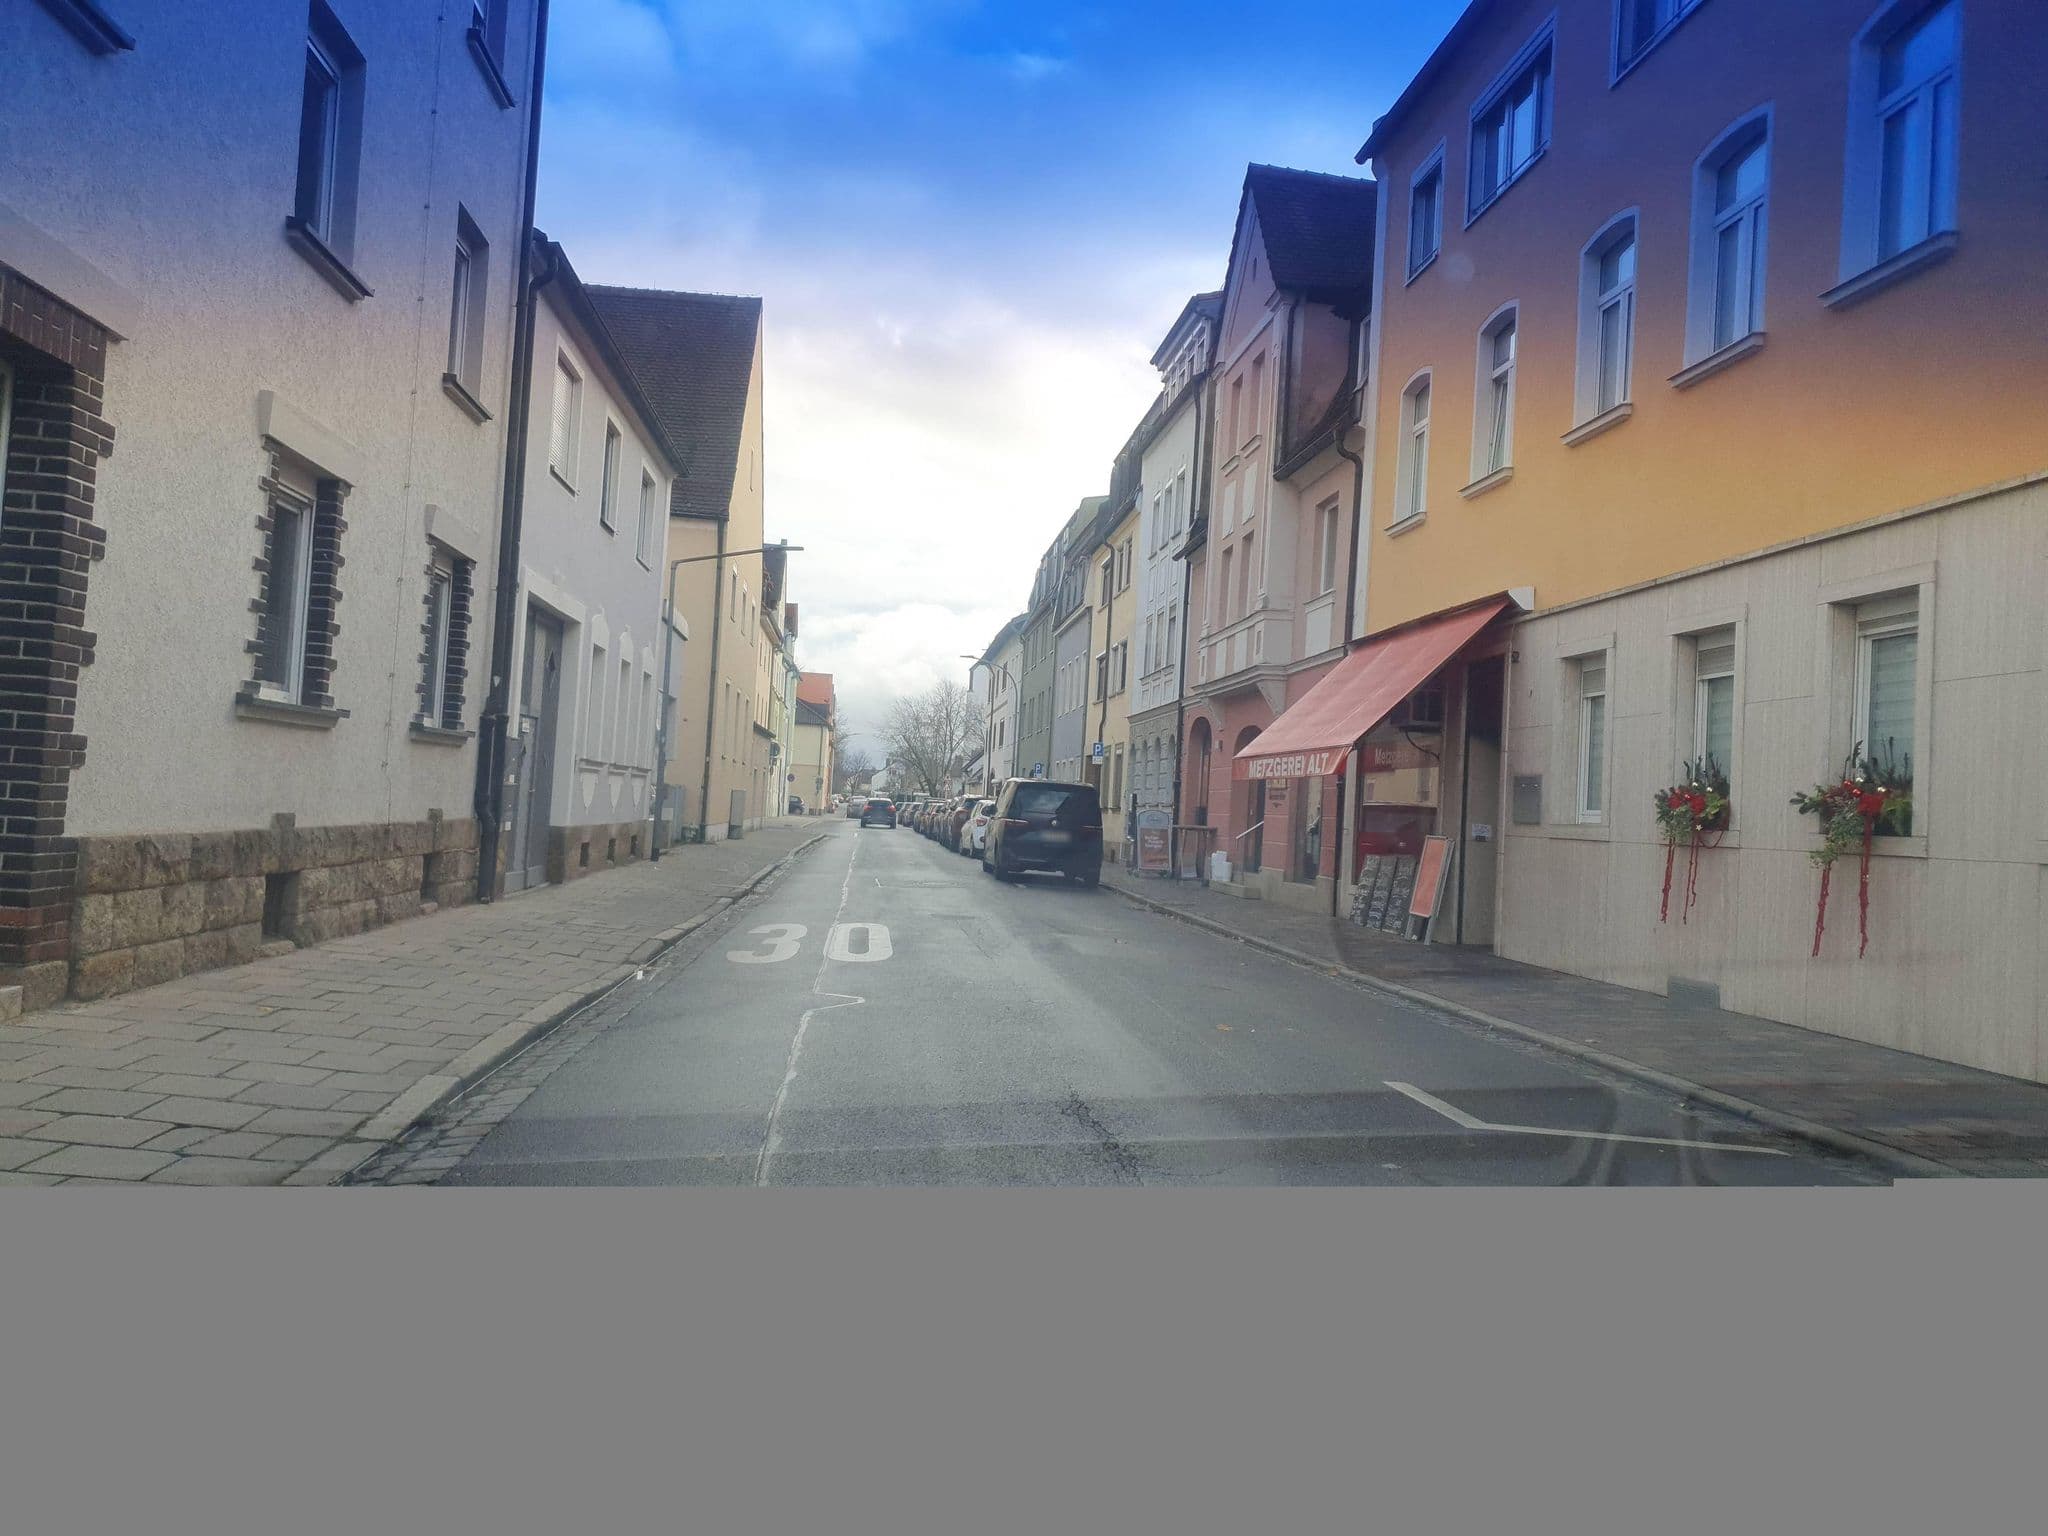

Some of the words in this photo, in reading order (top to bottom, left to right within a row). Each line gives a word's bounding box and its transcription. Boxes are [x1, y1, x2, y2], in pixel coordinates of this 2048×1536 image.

[1095, 744, 1102, 756] P
[1249, 755, 1305, 779] METZGEREI
[1307, 752, 1329, 775] ALT
[726, 922, 894, 964] 30
